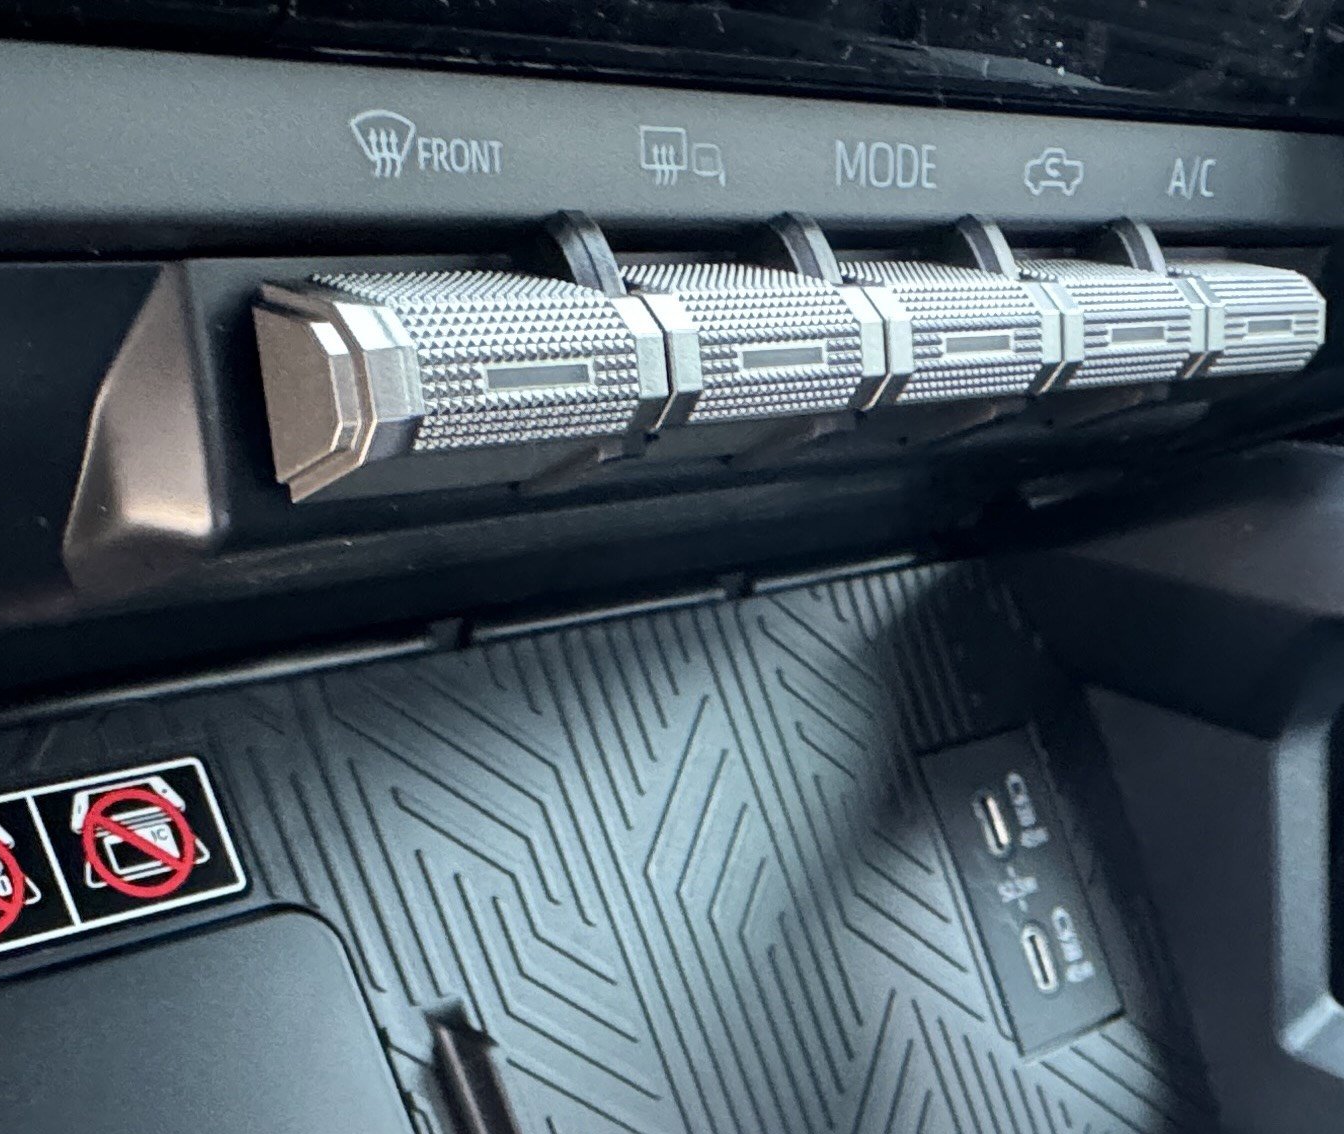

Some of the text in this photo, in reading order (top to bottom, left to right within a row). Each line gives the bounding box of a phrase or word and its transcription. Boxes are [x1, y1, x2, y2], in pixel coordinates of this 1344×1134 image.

[416, 137, 504, 174] FRONT
[835, 140, 937, 189] MODE
[1166, 155, 1217, 200] A/C
